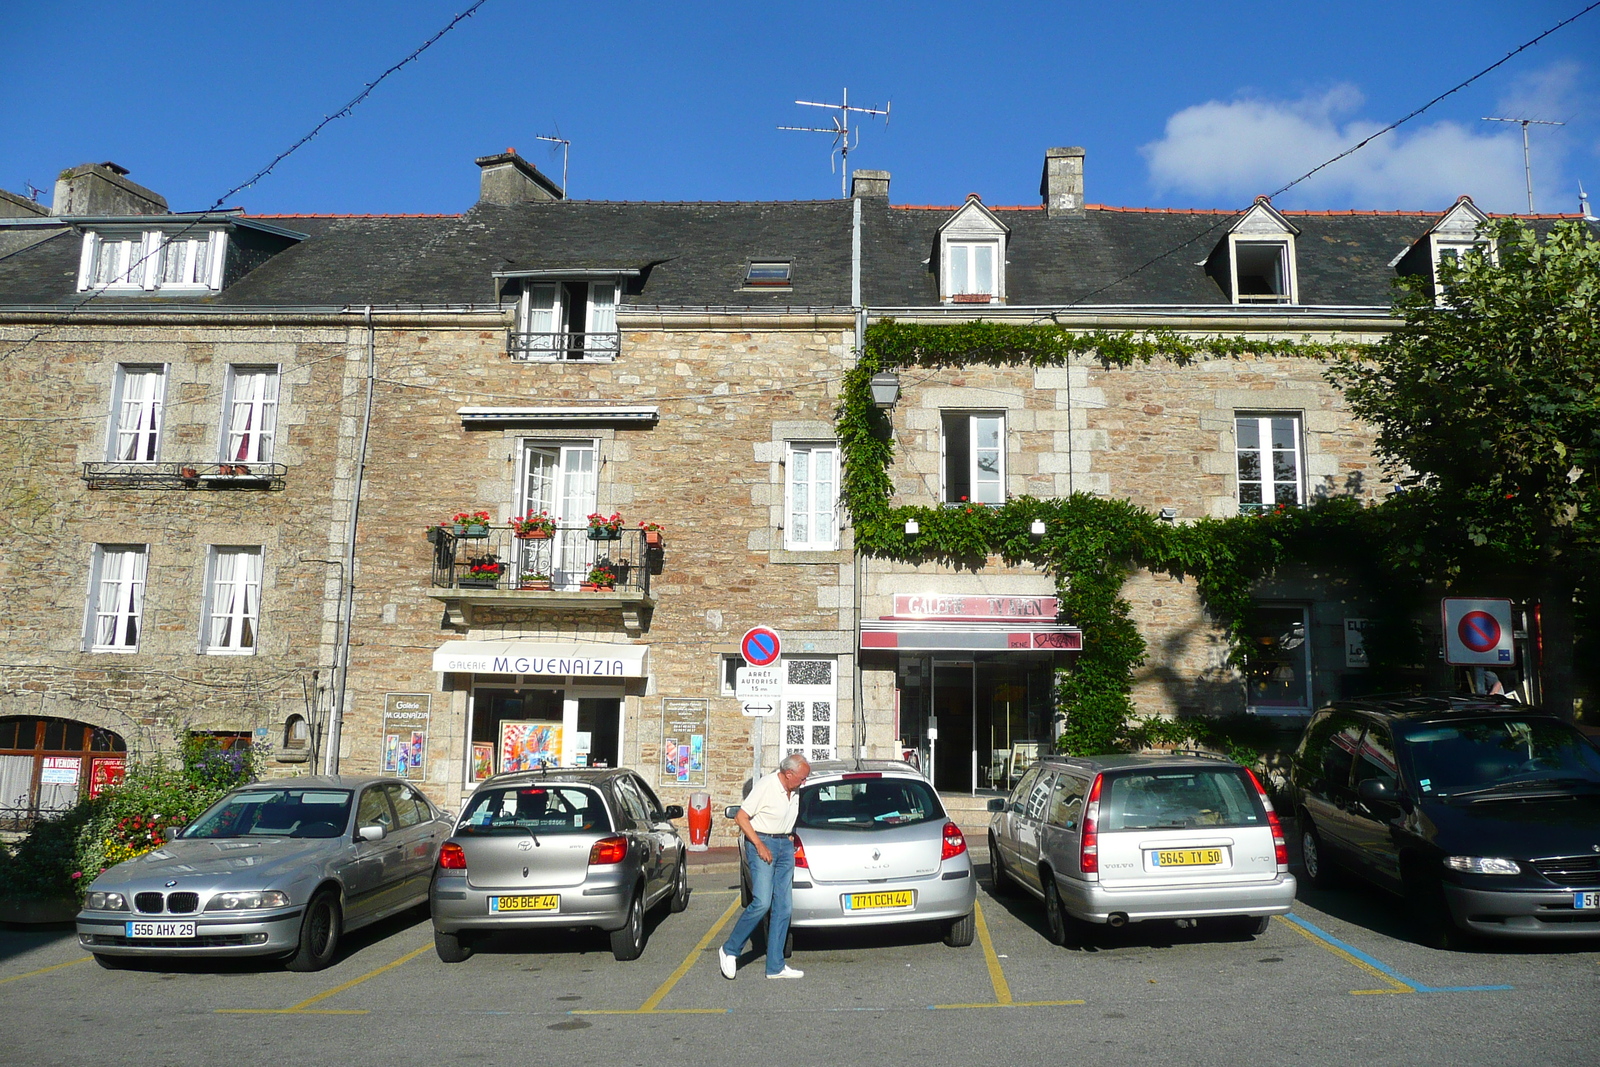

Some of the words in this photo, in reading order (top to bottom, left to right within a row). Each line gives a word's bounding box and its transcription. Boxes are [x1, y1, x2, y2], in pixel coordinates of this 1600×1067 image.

[448, 661, 487, 670] GALERIE
[55, 758, 79, 769] VENDRE
[1160, 853, 1184, 865] 5645
[1191, 852, 1202, 864] TY
[1208, 851, 1220, 863] 50
[499, 897, 518, 909] 905
[520, 896, 540, 908] BEF
[542, 896, 556, 907] 44
[854, 895, 872, 907] 771
[874, 893, 893, 906] CCH
[895, 892, 907, 904] 44
[134, 924, 153, 936] 556
[156, 924, 176, 936] AHX
[179, 924, 193, 936] 29
